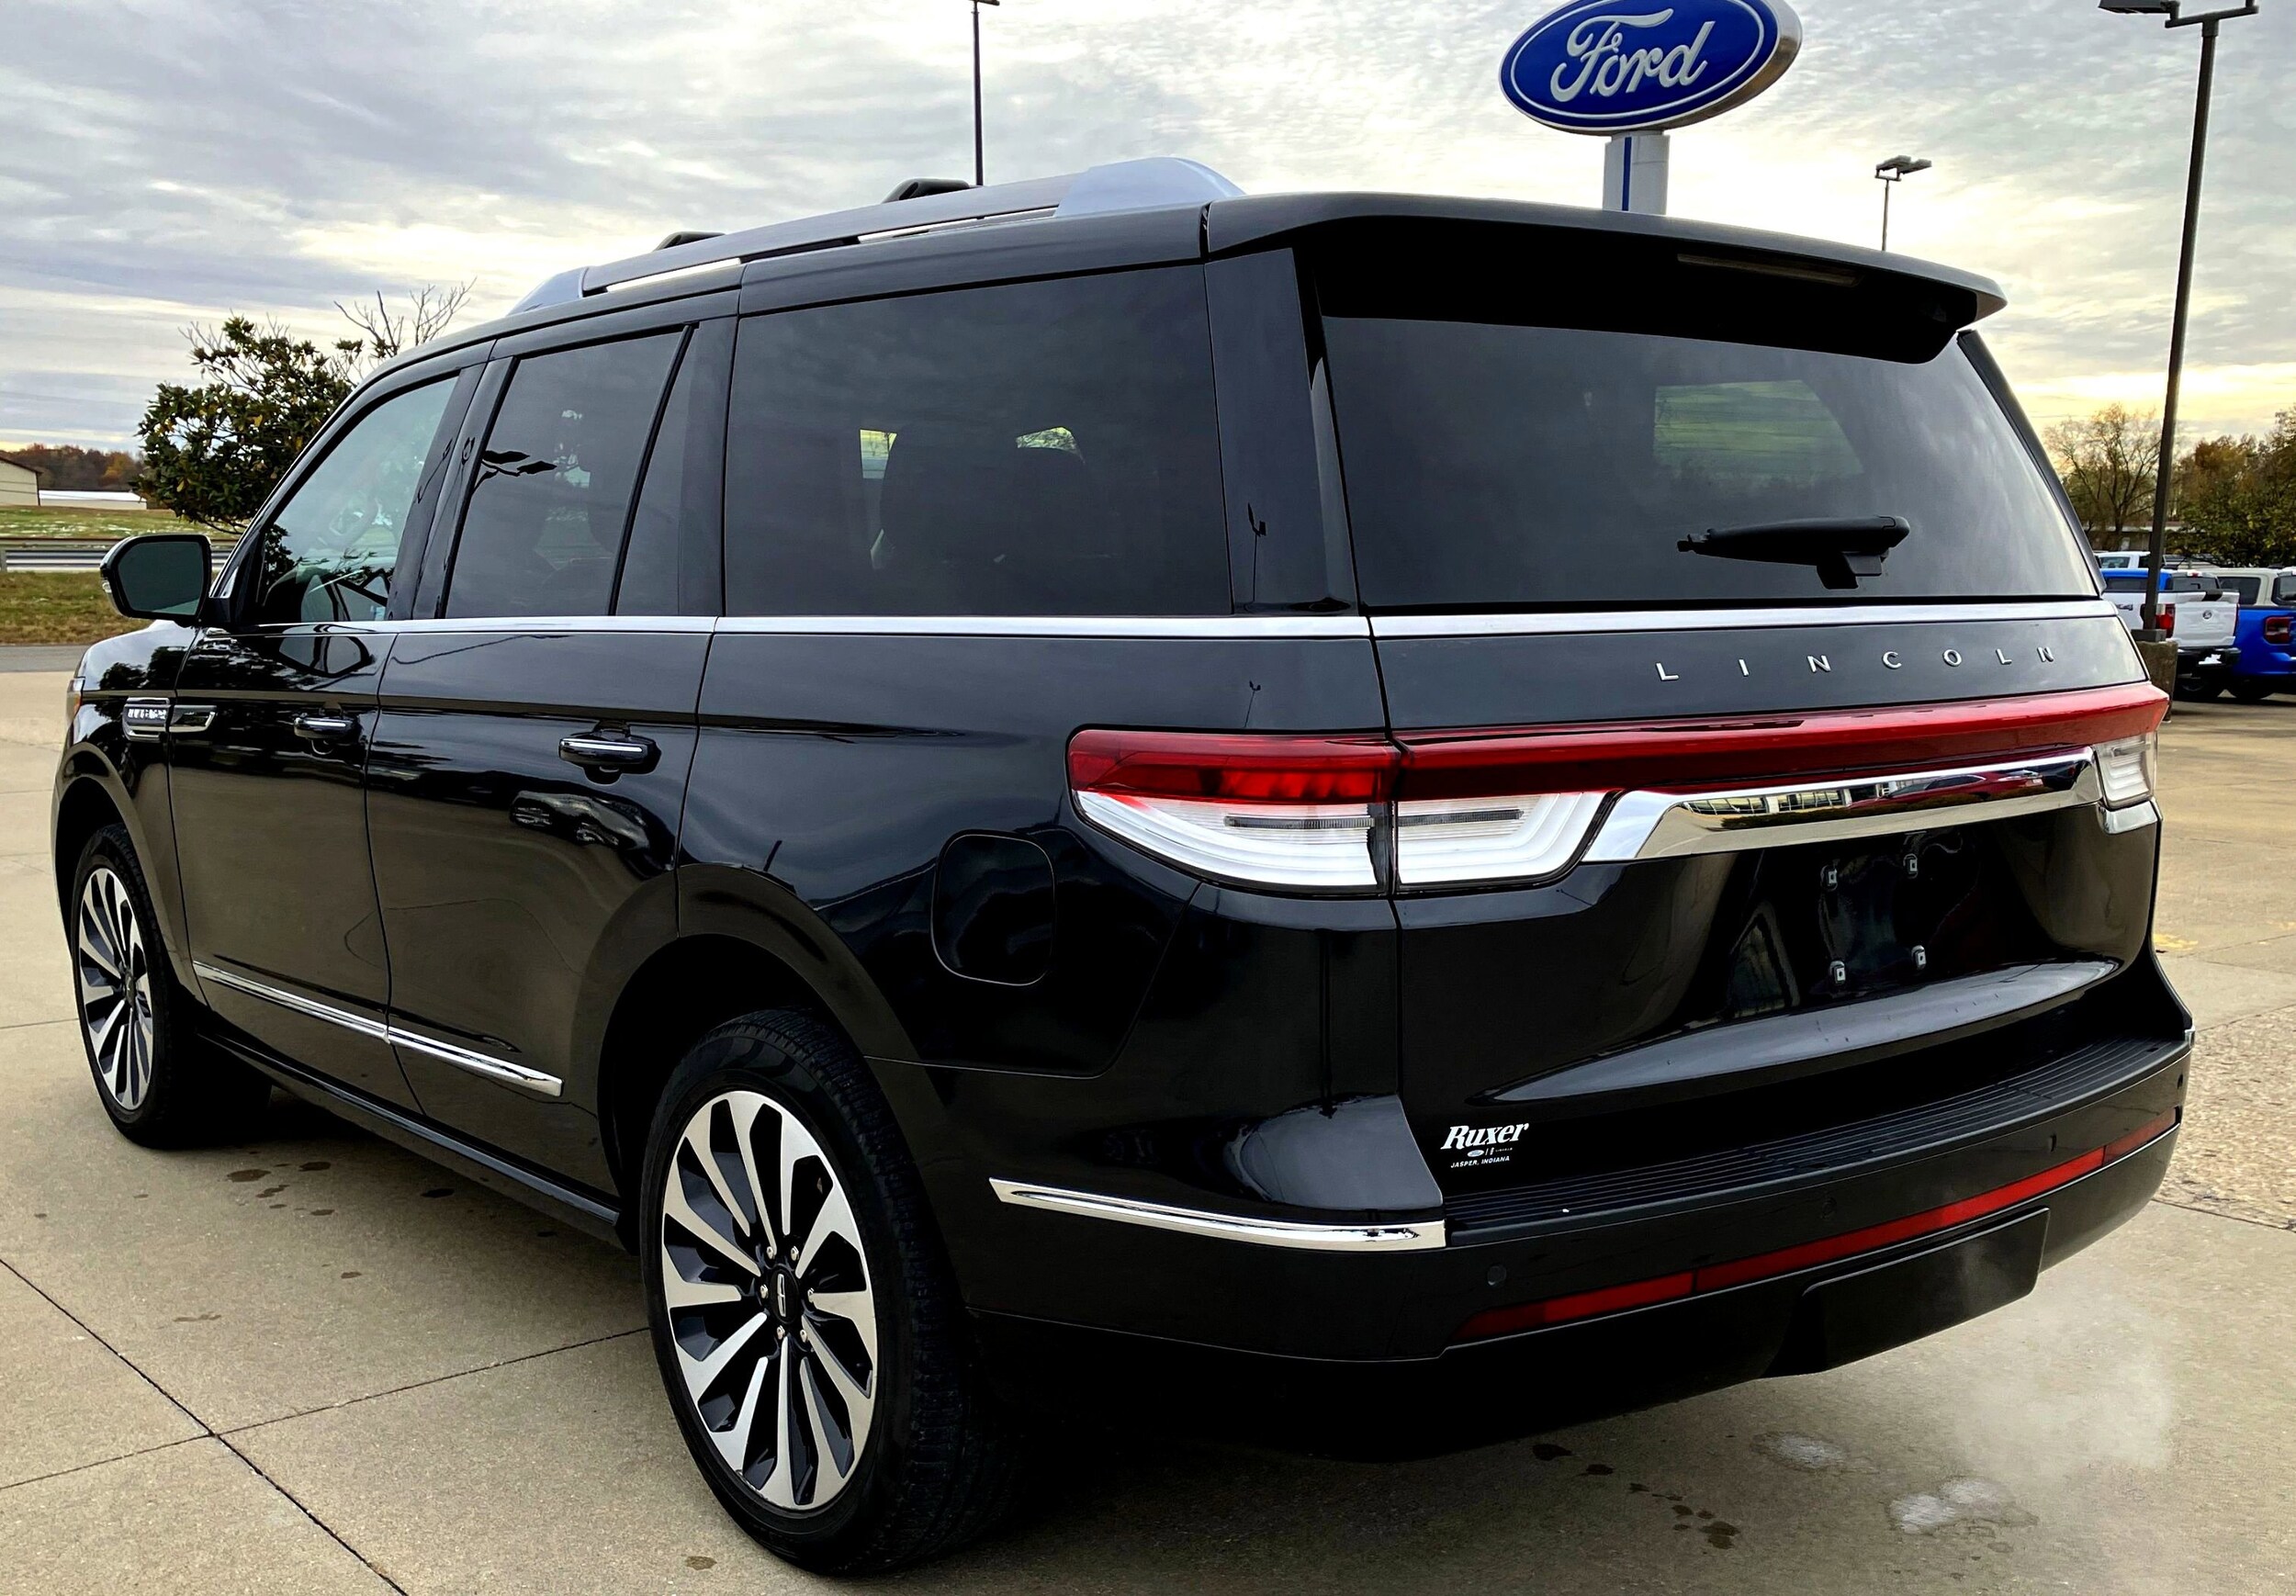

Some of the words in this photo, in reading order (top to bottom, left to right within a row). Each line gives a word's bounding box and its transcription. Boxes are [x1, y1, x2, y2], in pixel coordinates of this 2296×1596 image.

[1550, 8, 1716, 102] Ford
[1656, 646, 2054, 682] LINCOLN
[1440, 1122, 1530, 1150] Ruxer
[1480, 1155, 1511, 1165] INDIANA
